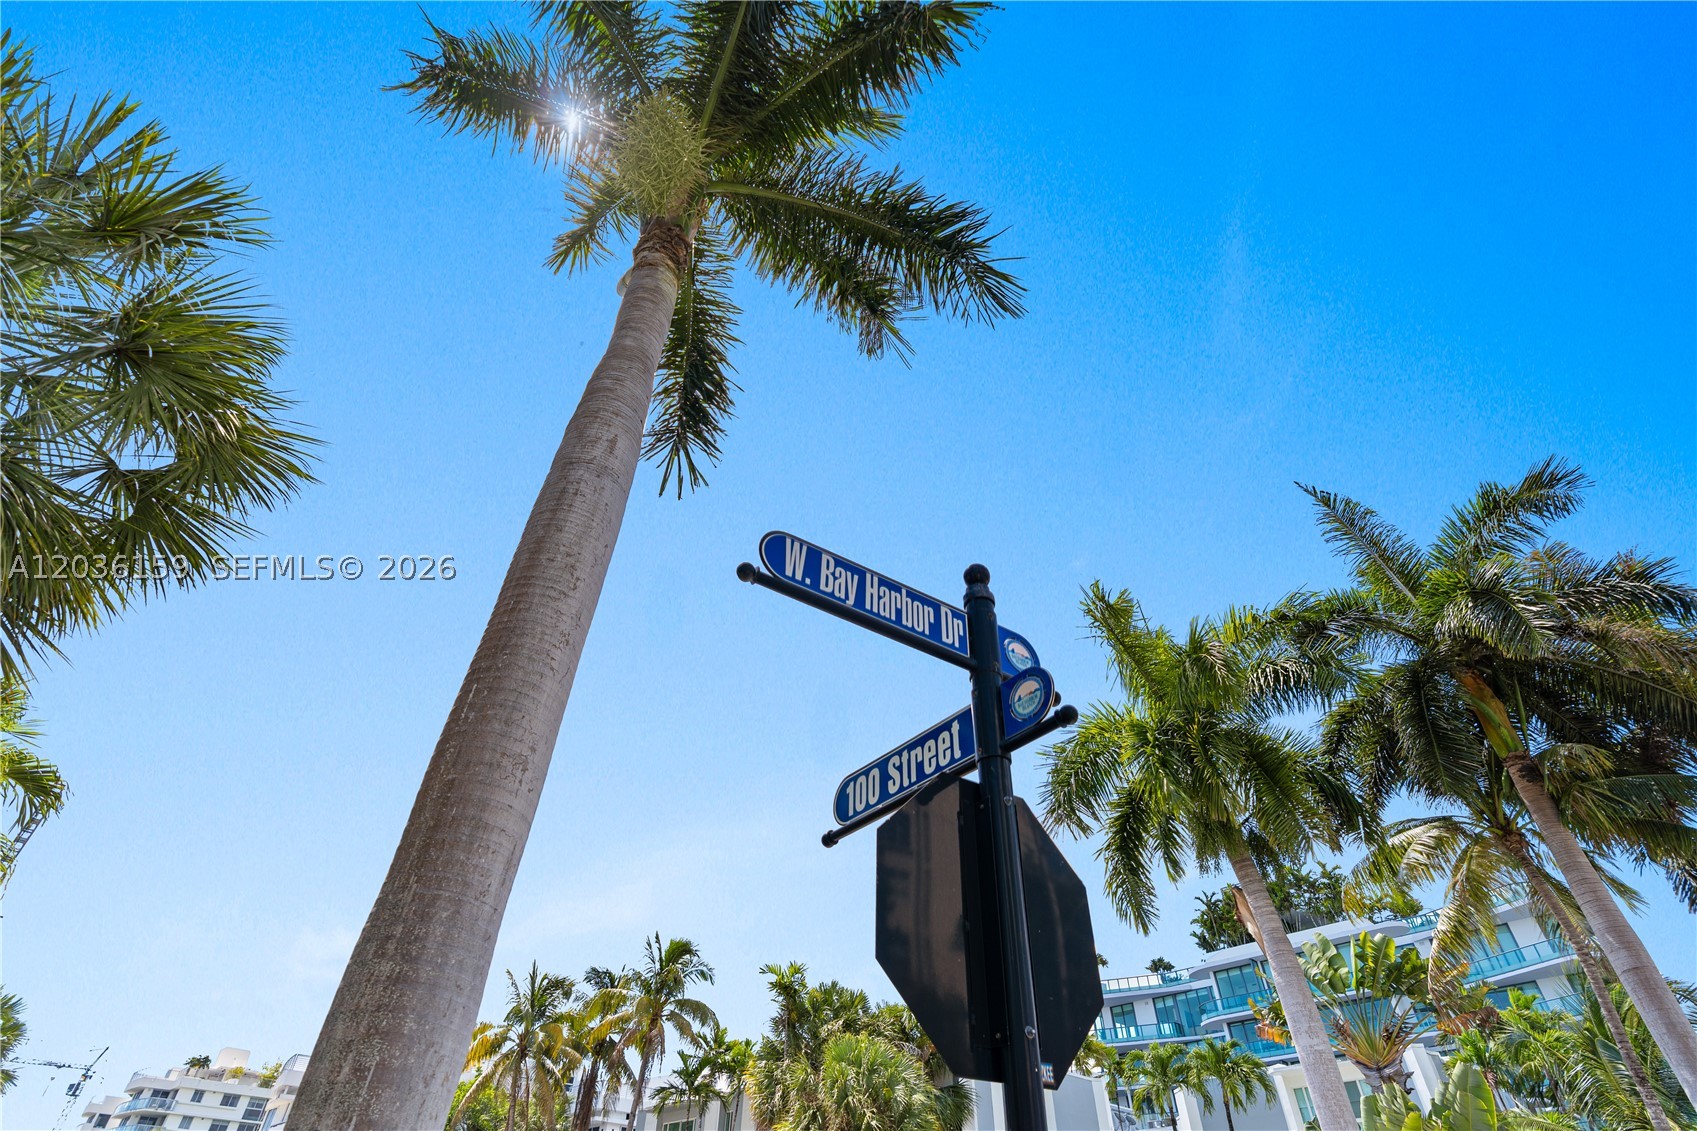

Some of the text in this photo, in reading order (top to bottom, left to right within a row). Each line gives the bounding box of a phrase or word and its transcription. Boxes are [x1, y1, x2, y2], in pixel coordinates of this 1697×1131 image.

[785, 535, 964, 648] W. Bay Harbor Dr
[846, 718, 962, 817] 100 Street
